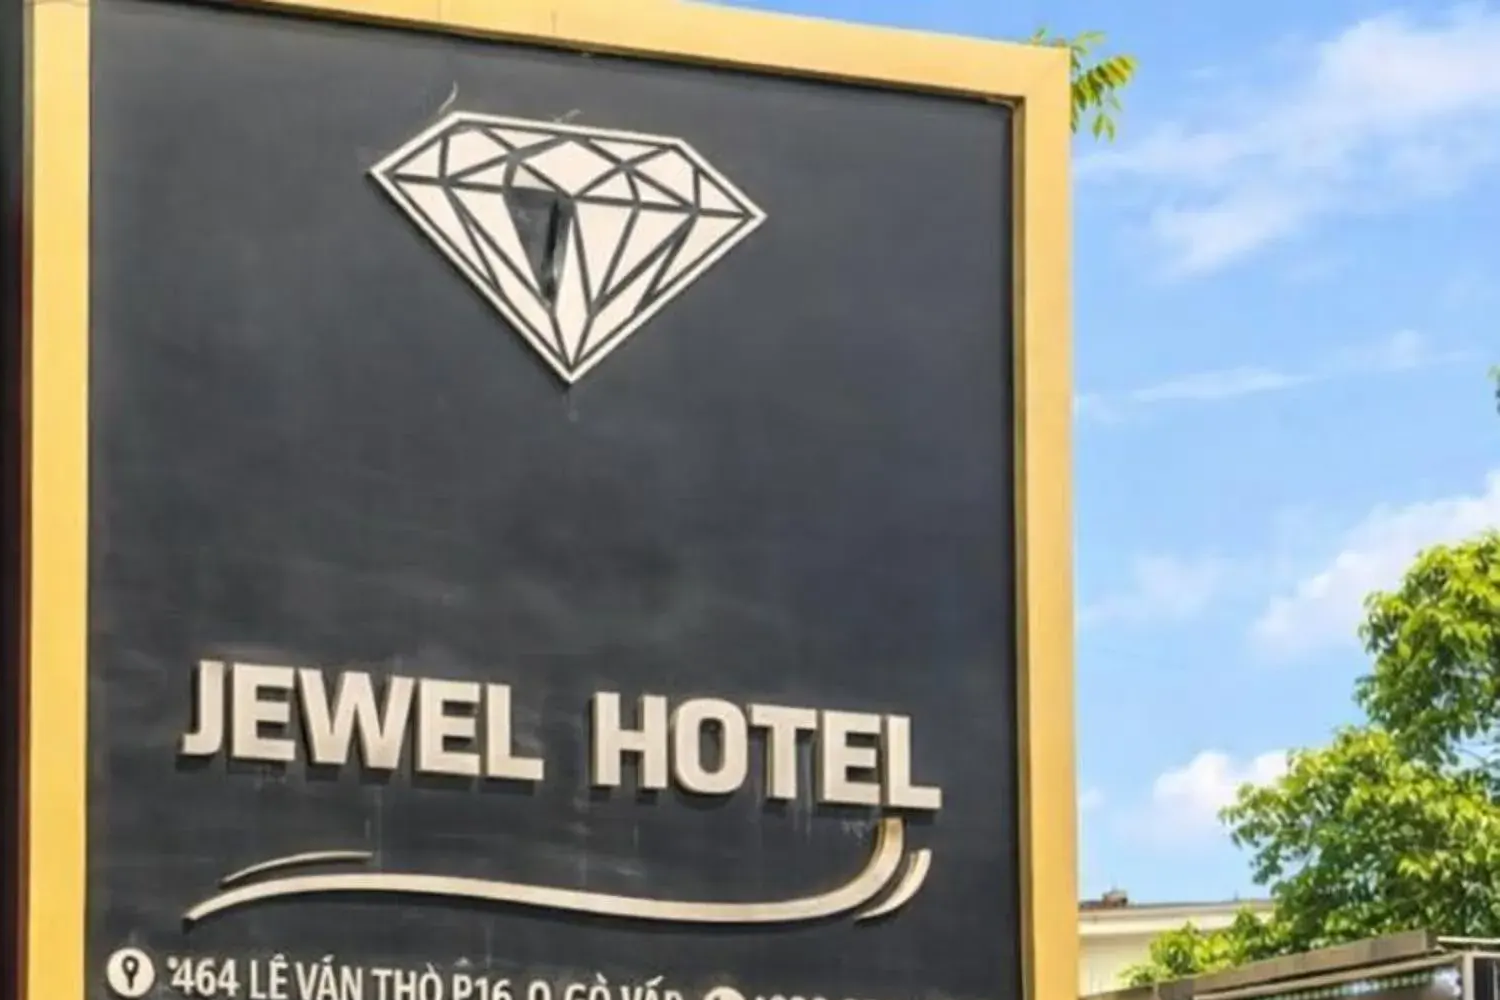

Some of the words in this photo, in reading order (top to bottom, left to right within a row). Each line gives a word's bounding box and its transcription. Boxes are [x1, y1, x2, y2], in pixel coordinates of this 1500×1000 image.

[179, 659, 545, 784] JEWEL
[591, 690, 942, 809] HOTEL
[250, 954, 289, 1000] LÊ
